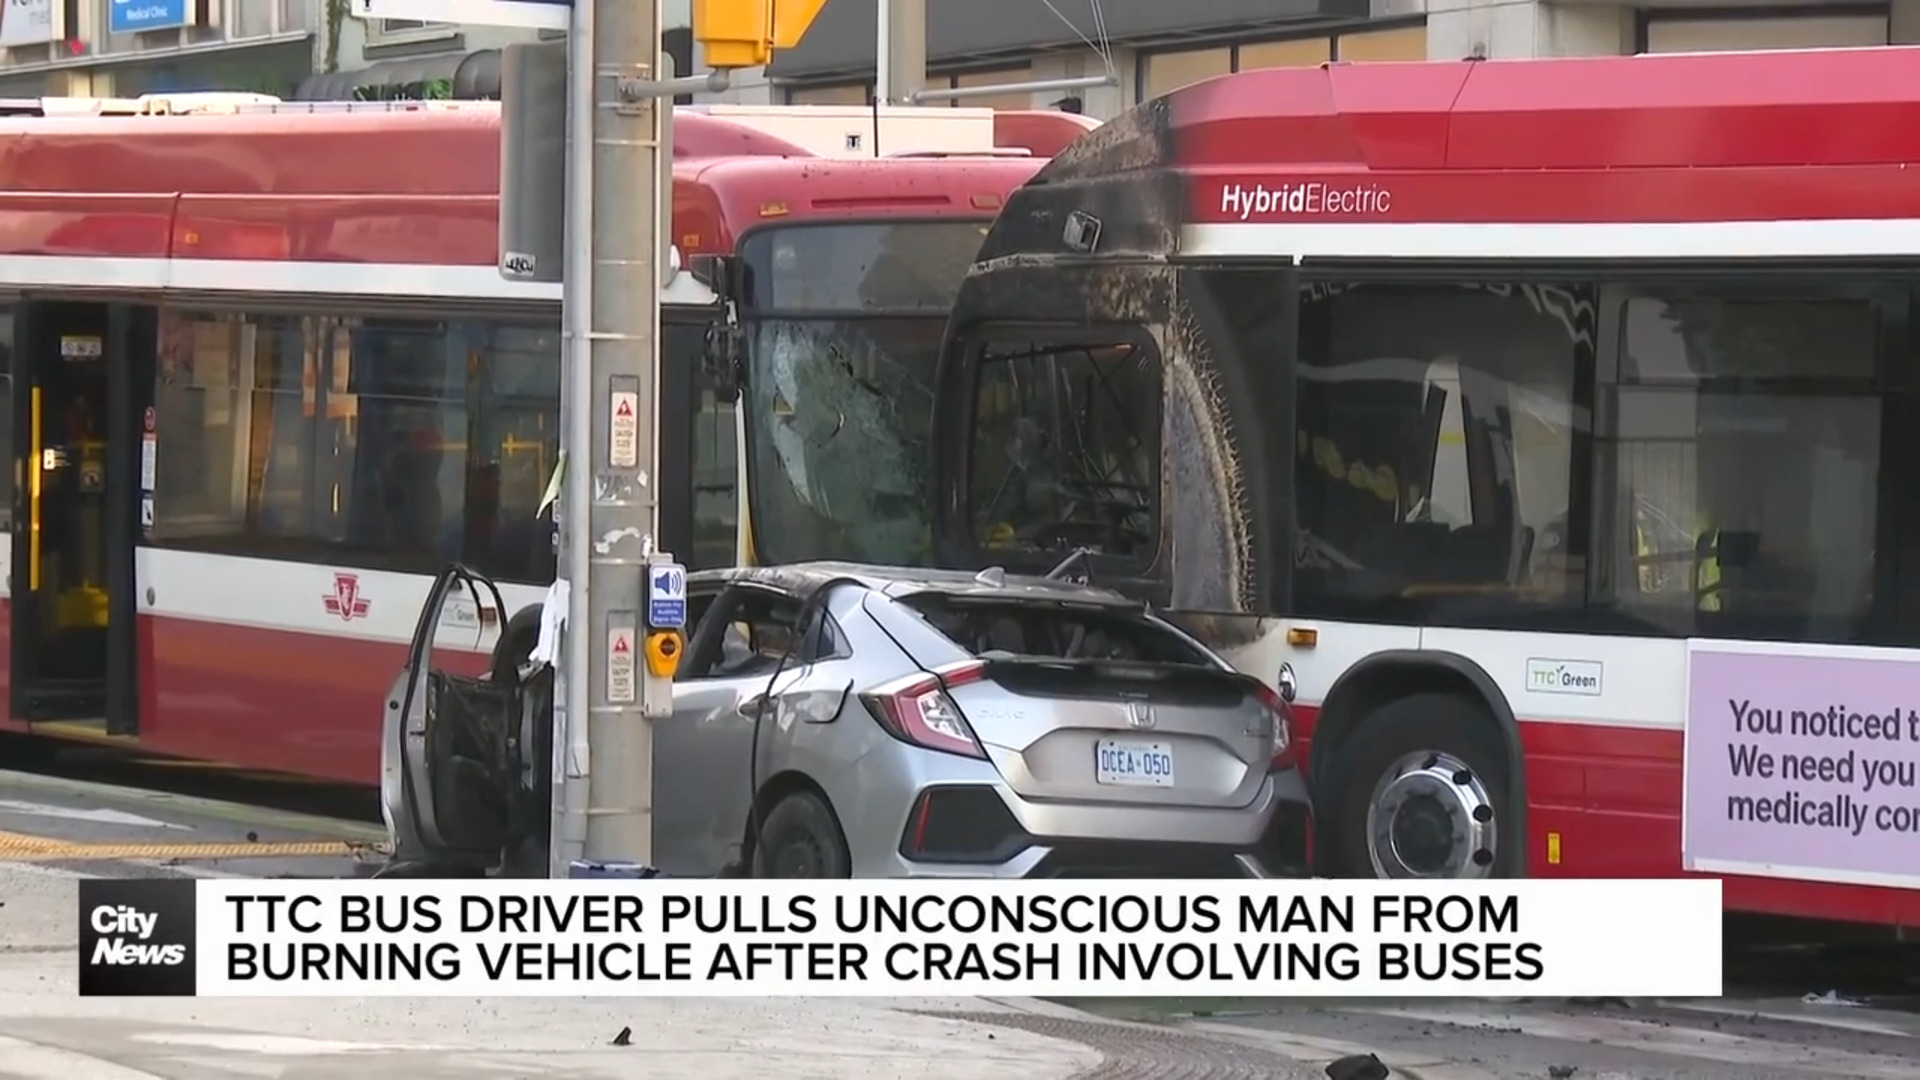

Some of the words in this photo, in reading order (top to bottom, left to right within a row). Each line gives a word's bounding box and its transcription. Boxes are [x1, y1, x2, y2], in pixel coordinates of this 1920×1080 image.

[1729, 699, 1782, 734] You
[1791, 705, 1900, 741] noticed
[1728, 743, 1774, 778] We
[1782, 750, 1854, 783] need
[1862, 759, 1915, 792] you
[1728, 791, 1868, 836] medically
